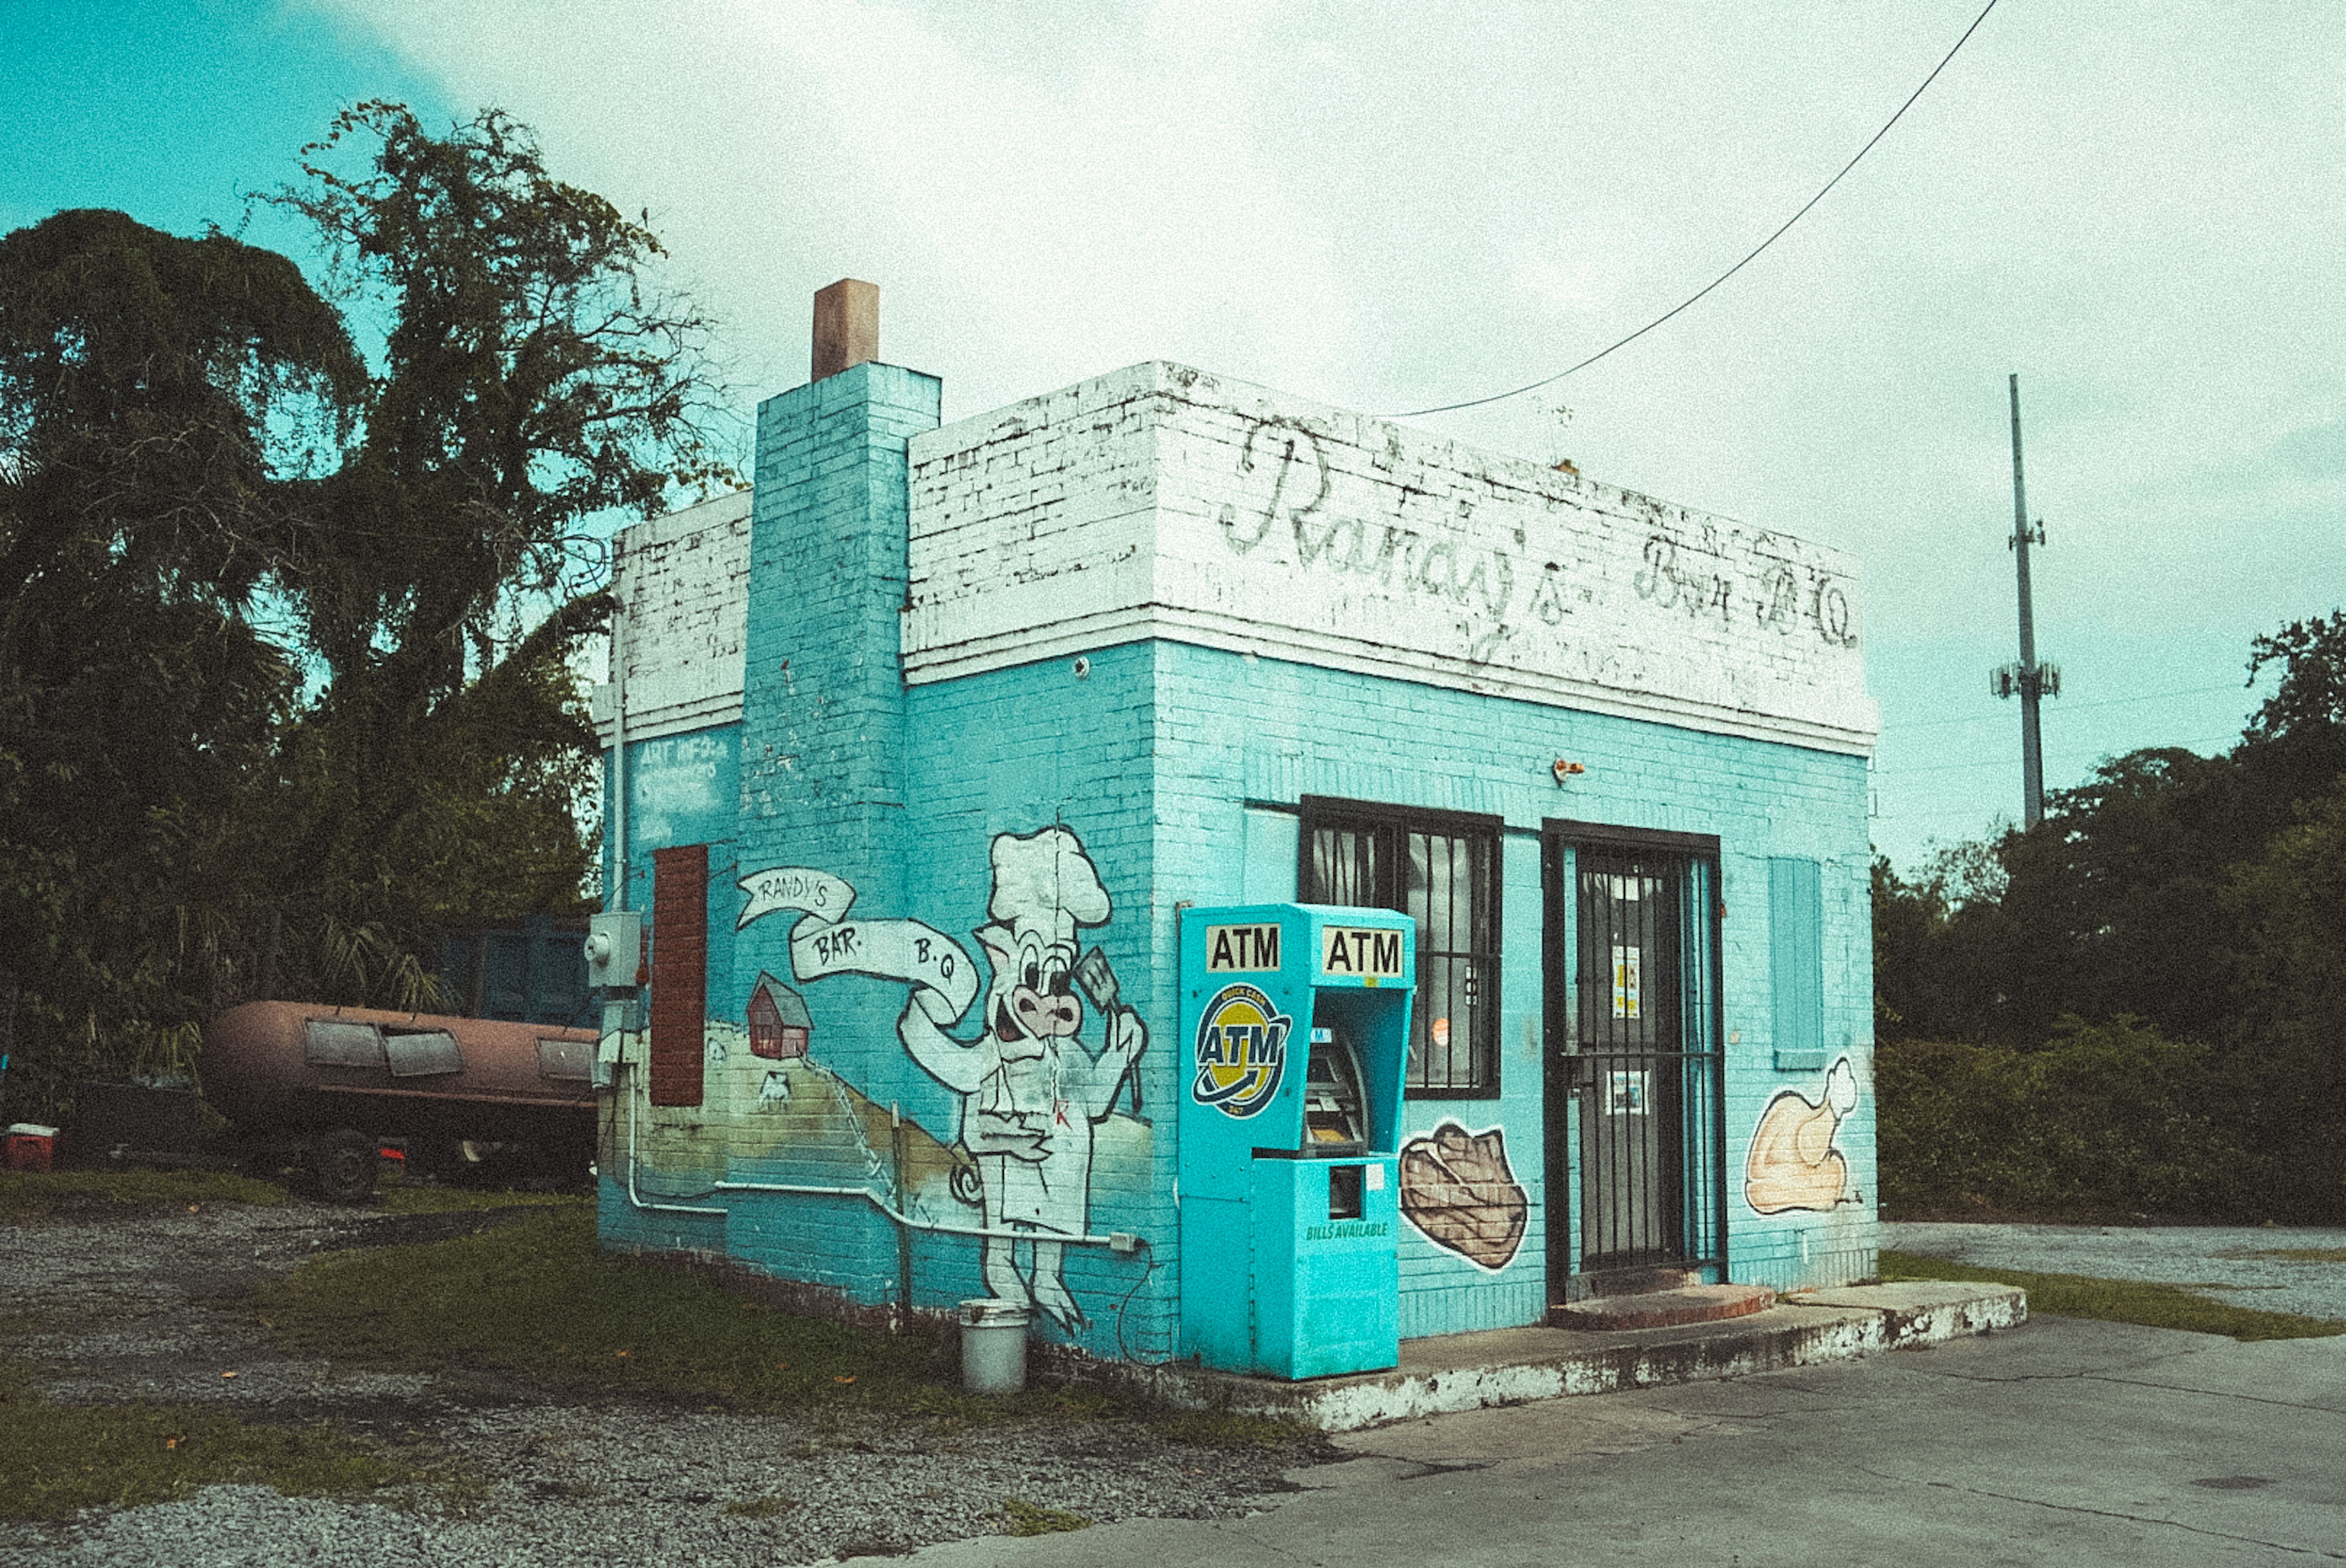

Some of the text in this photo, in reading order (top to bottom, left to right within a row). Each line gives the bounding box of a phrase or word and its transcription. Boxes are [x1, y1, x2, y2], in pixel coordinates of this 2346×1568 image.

[759, 877, 827, 906] RANDY'S
[1212, 928, 1277, 968] ATM
[1327, 931, 1398, 973] ATM
[1221, 987, 1266, 1006] QUICK CASH
[1198, 1024, 1279, 1066] ATM
[1306, 1222, 1388, 1241] BILLS AVAILABLE
